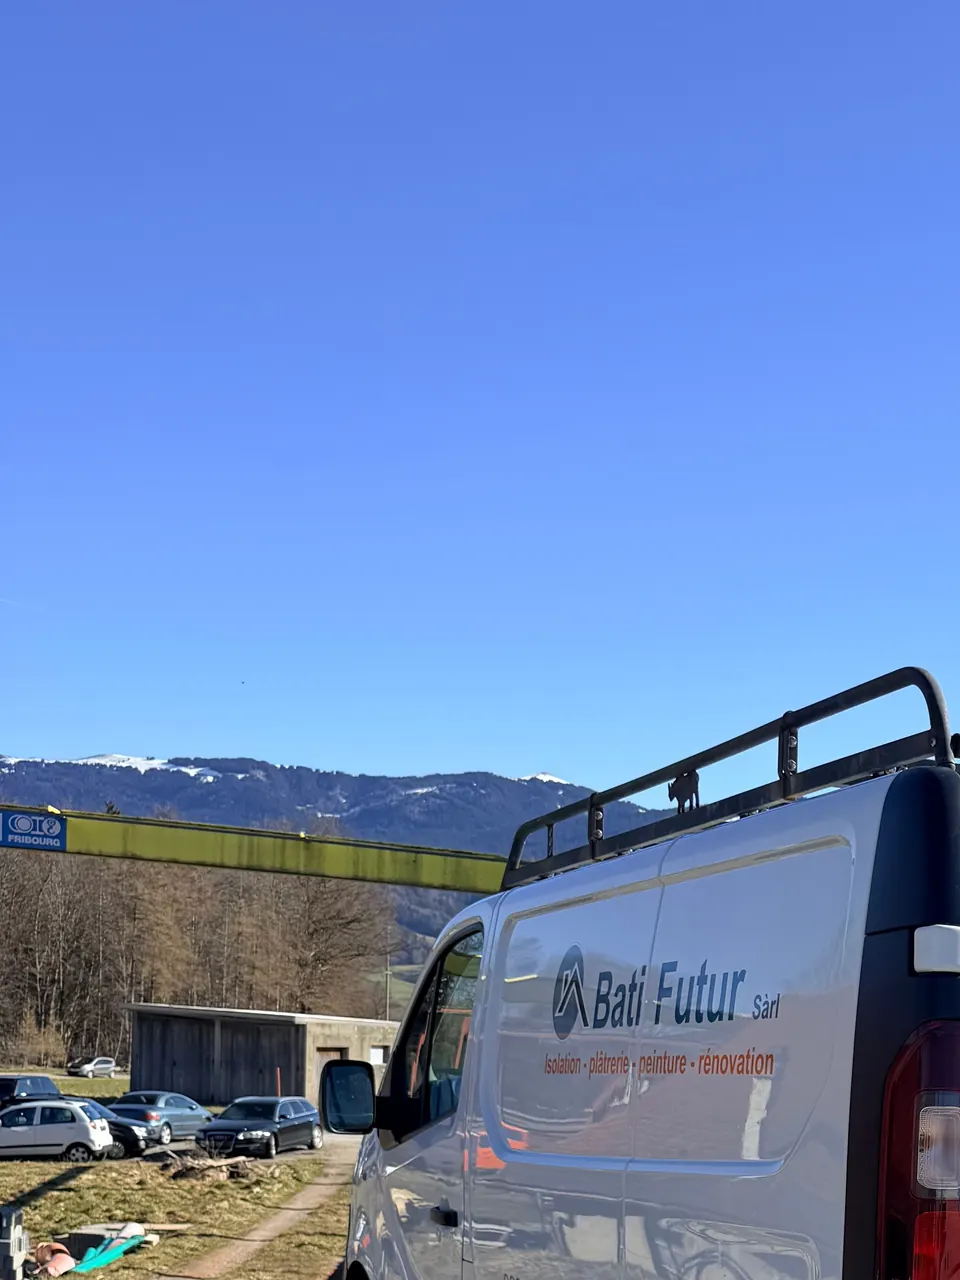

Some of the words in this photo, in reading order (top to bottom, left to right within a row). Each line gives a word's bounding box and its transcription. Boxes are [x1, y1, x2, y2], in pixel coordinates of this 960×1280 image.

[8, 834, 60, 847] FRIBOURG
[593, 965, 647, 1029] Bati
[654, 958, 747, 1025] Futur
[752, 993, 781, 1020] Sàrl
[544, 1052, 581, 1075] Isolation
[588, 1050, 629, 1080] plâtrerie
[638, 1050, 687, 1080] peinture
[698, 1047, 775, 1076] rénovation
